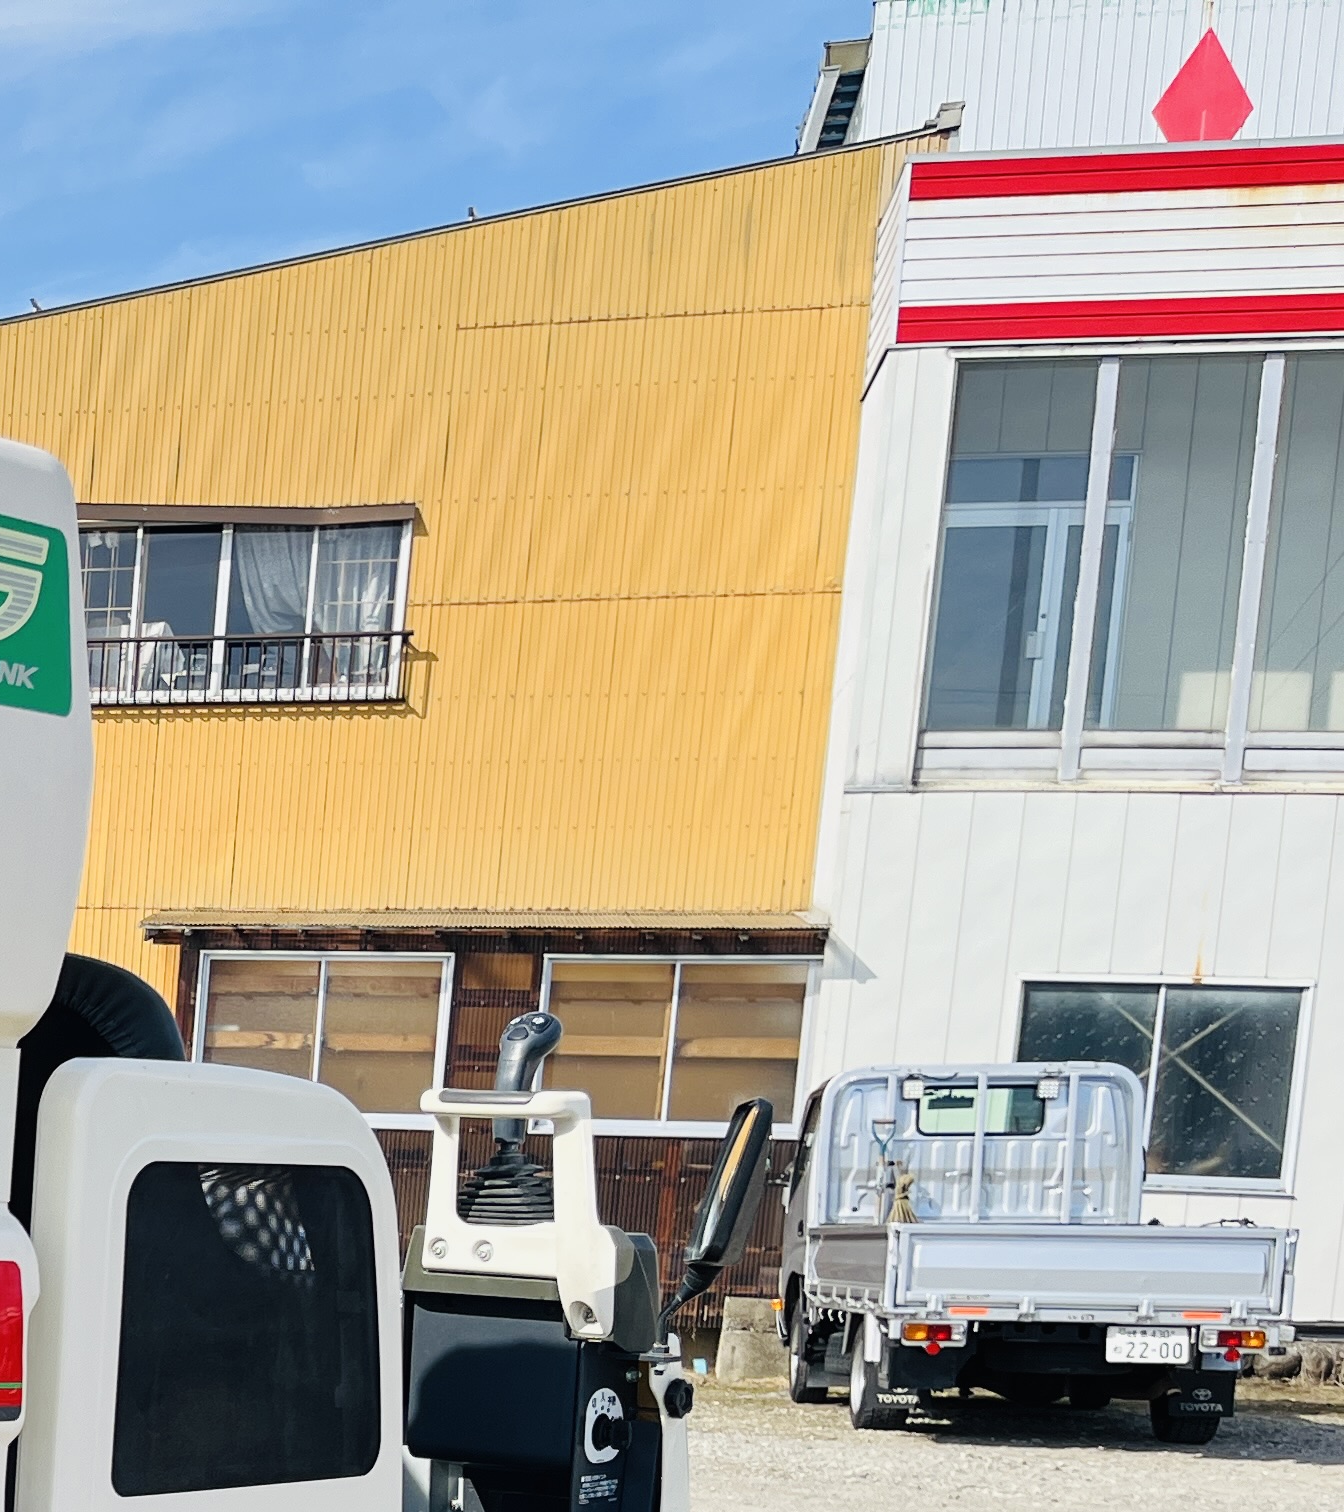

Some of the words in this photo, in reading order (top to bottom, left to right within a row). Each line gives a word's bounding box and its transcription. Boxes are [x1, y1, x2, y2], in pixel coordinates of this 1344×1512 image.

[1125, 1341, 1183, 1360] 22-00
[876, 1393, 920, 1405] TOYOTA
[1179, 1402, 1223, 1412] TOYOTA
